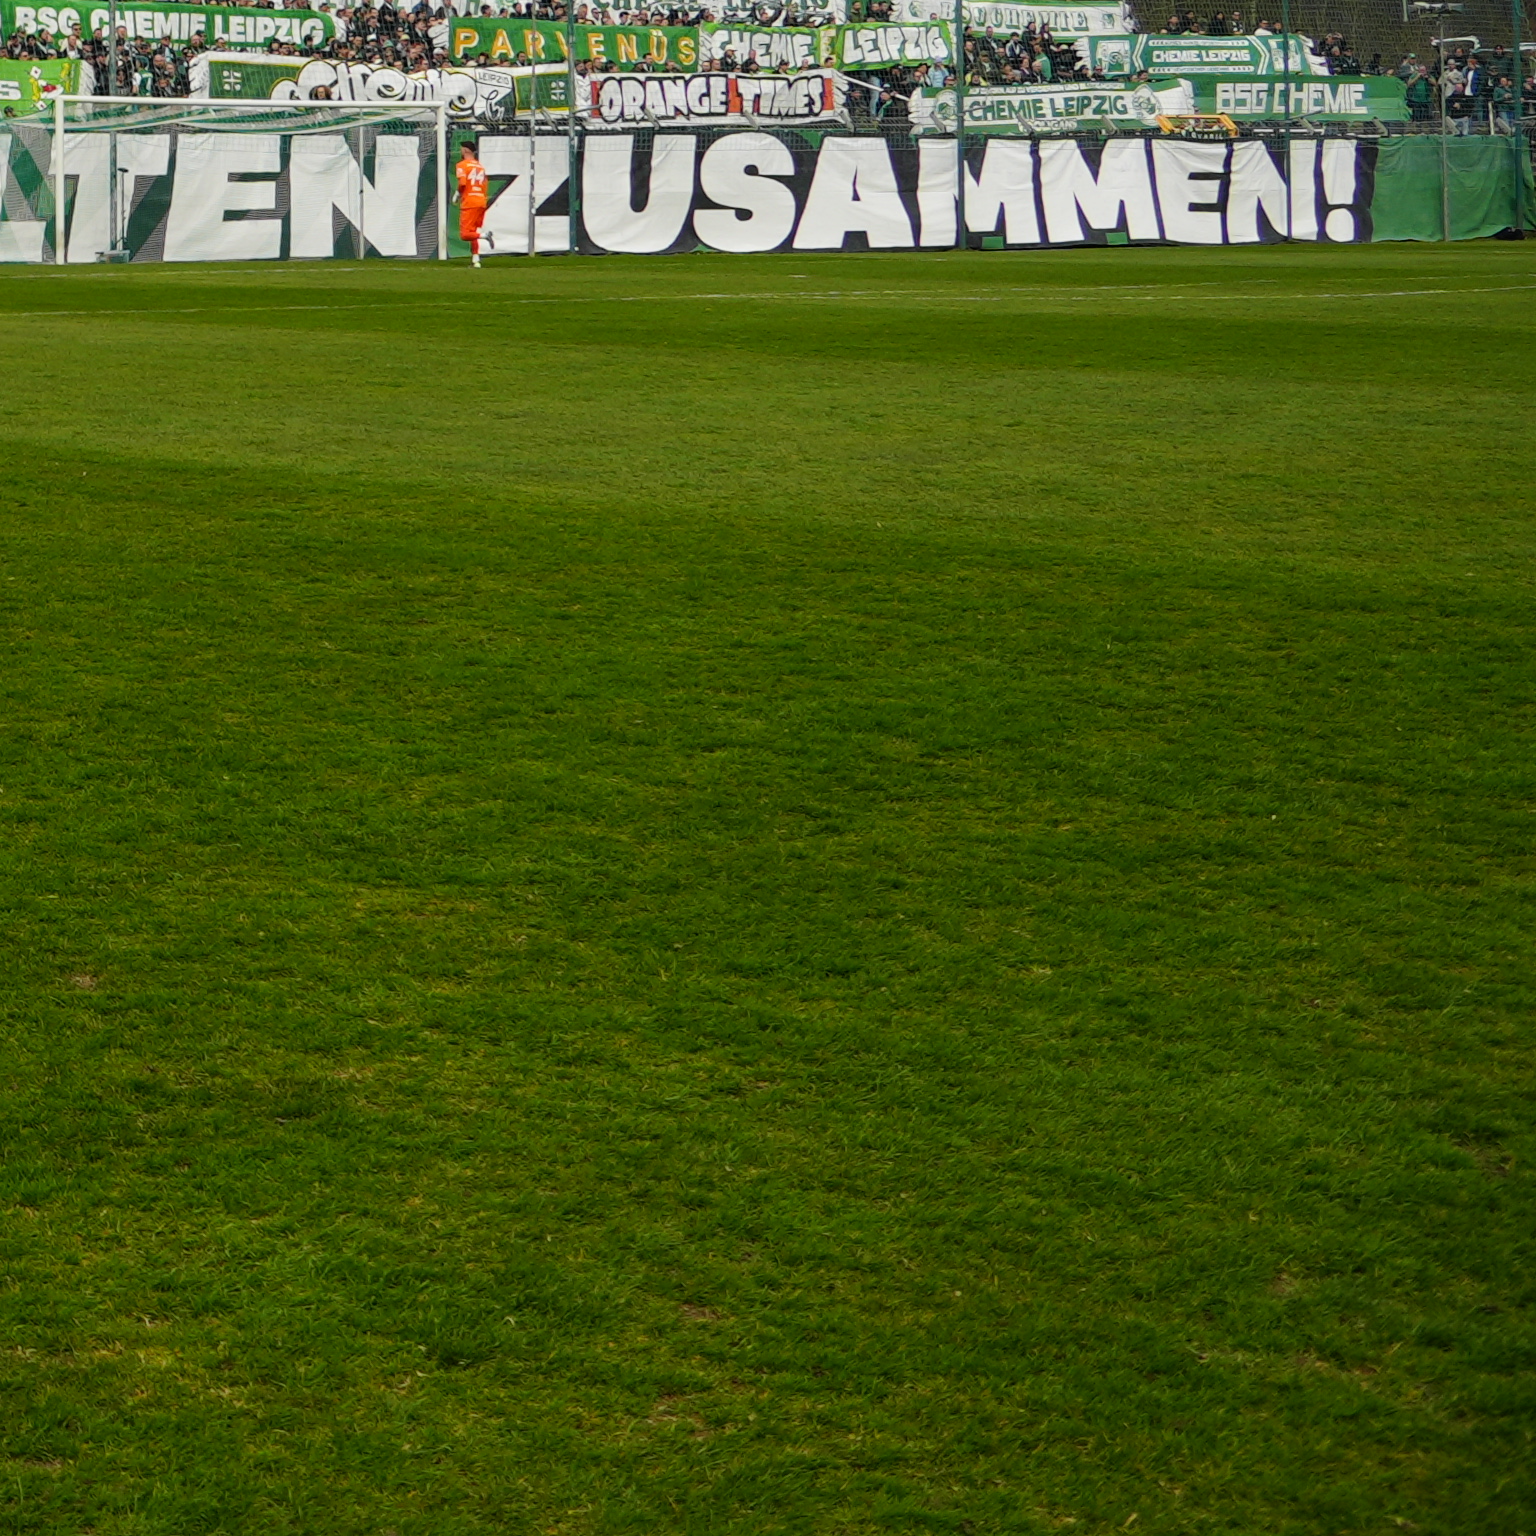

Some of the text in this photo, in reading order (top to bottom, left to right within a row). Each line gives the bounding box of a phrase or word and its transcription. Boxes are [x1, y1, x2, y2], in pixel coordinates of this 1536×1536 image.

[15, 6, 325, 46] BSG CHEMIE LEIPZIG
[711, 26, 949, 70] CHEMIE LEIPZIG
[1152, 49, 1250, 62] CHEMIE LEIPZIG
[599, 75, 824, 122] ORANGE TIMES
[969, 95, 1128, 121] CHEMIE LEIPZIG
[1216, 82, 1369, 114] BSG CHEMIE
[468, 167, 485, 185] 44
[476, 132, 1357, 256] ZUSAMMEN!
